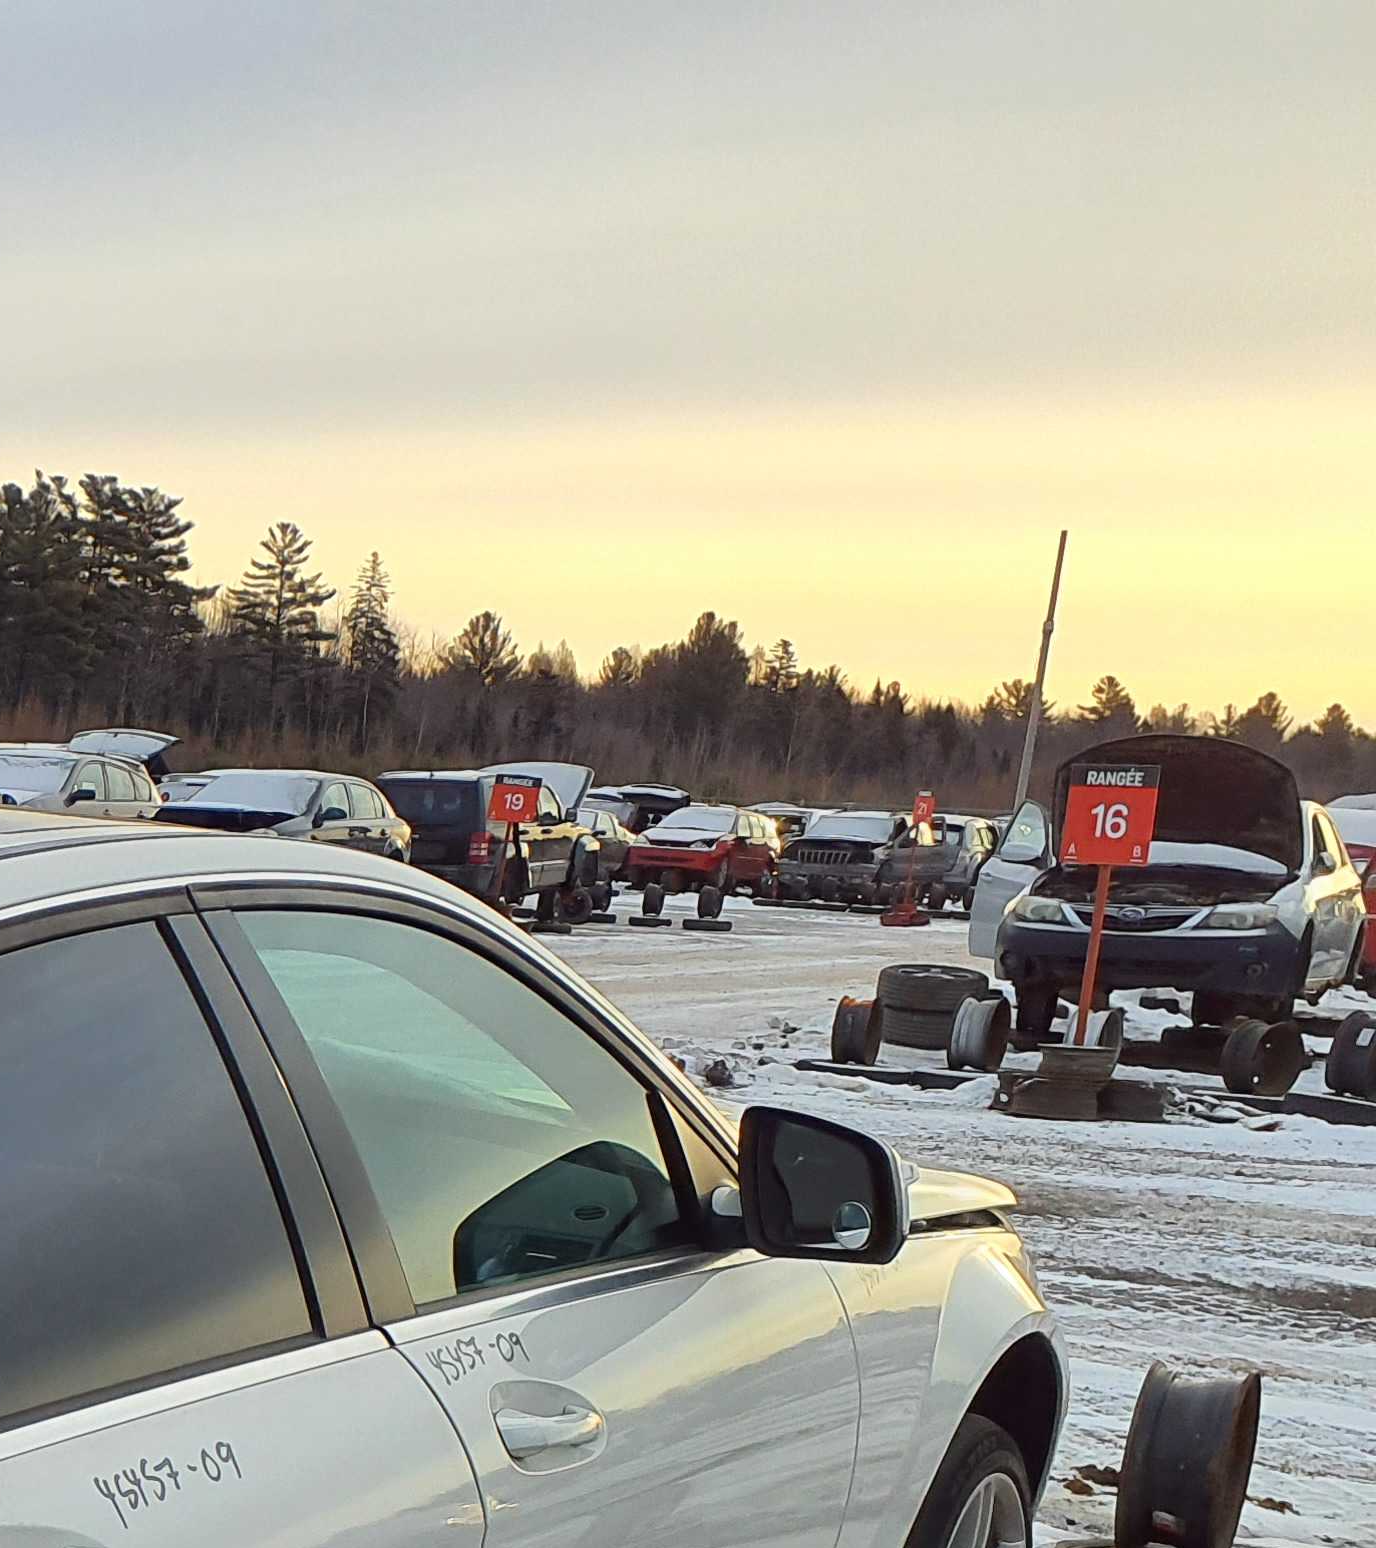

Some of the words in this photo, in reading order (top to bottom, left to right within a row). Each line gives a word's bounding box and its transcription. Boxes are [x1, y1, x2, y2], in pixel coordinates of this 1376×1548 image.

[1086, 767, 1145, 787] RANGÉE
[503, 792, 525, 811] 19
[1090, 803, 1129, 840] 16
[1067, 842, 1077, 855] A
[1132, 844, 1142, 858] B
[93, 1441, 242, 1530] 45457-09
